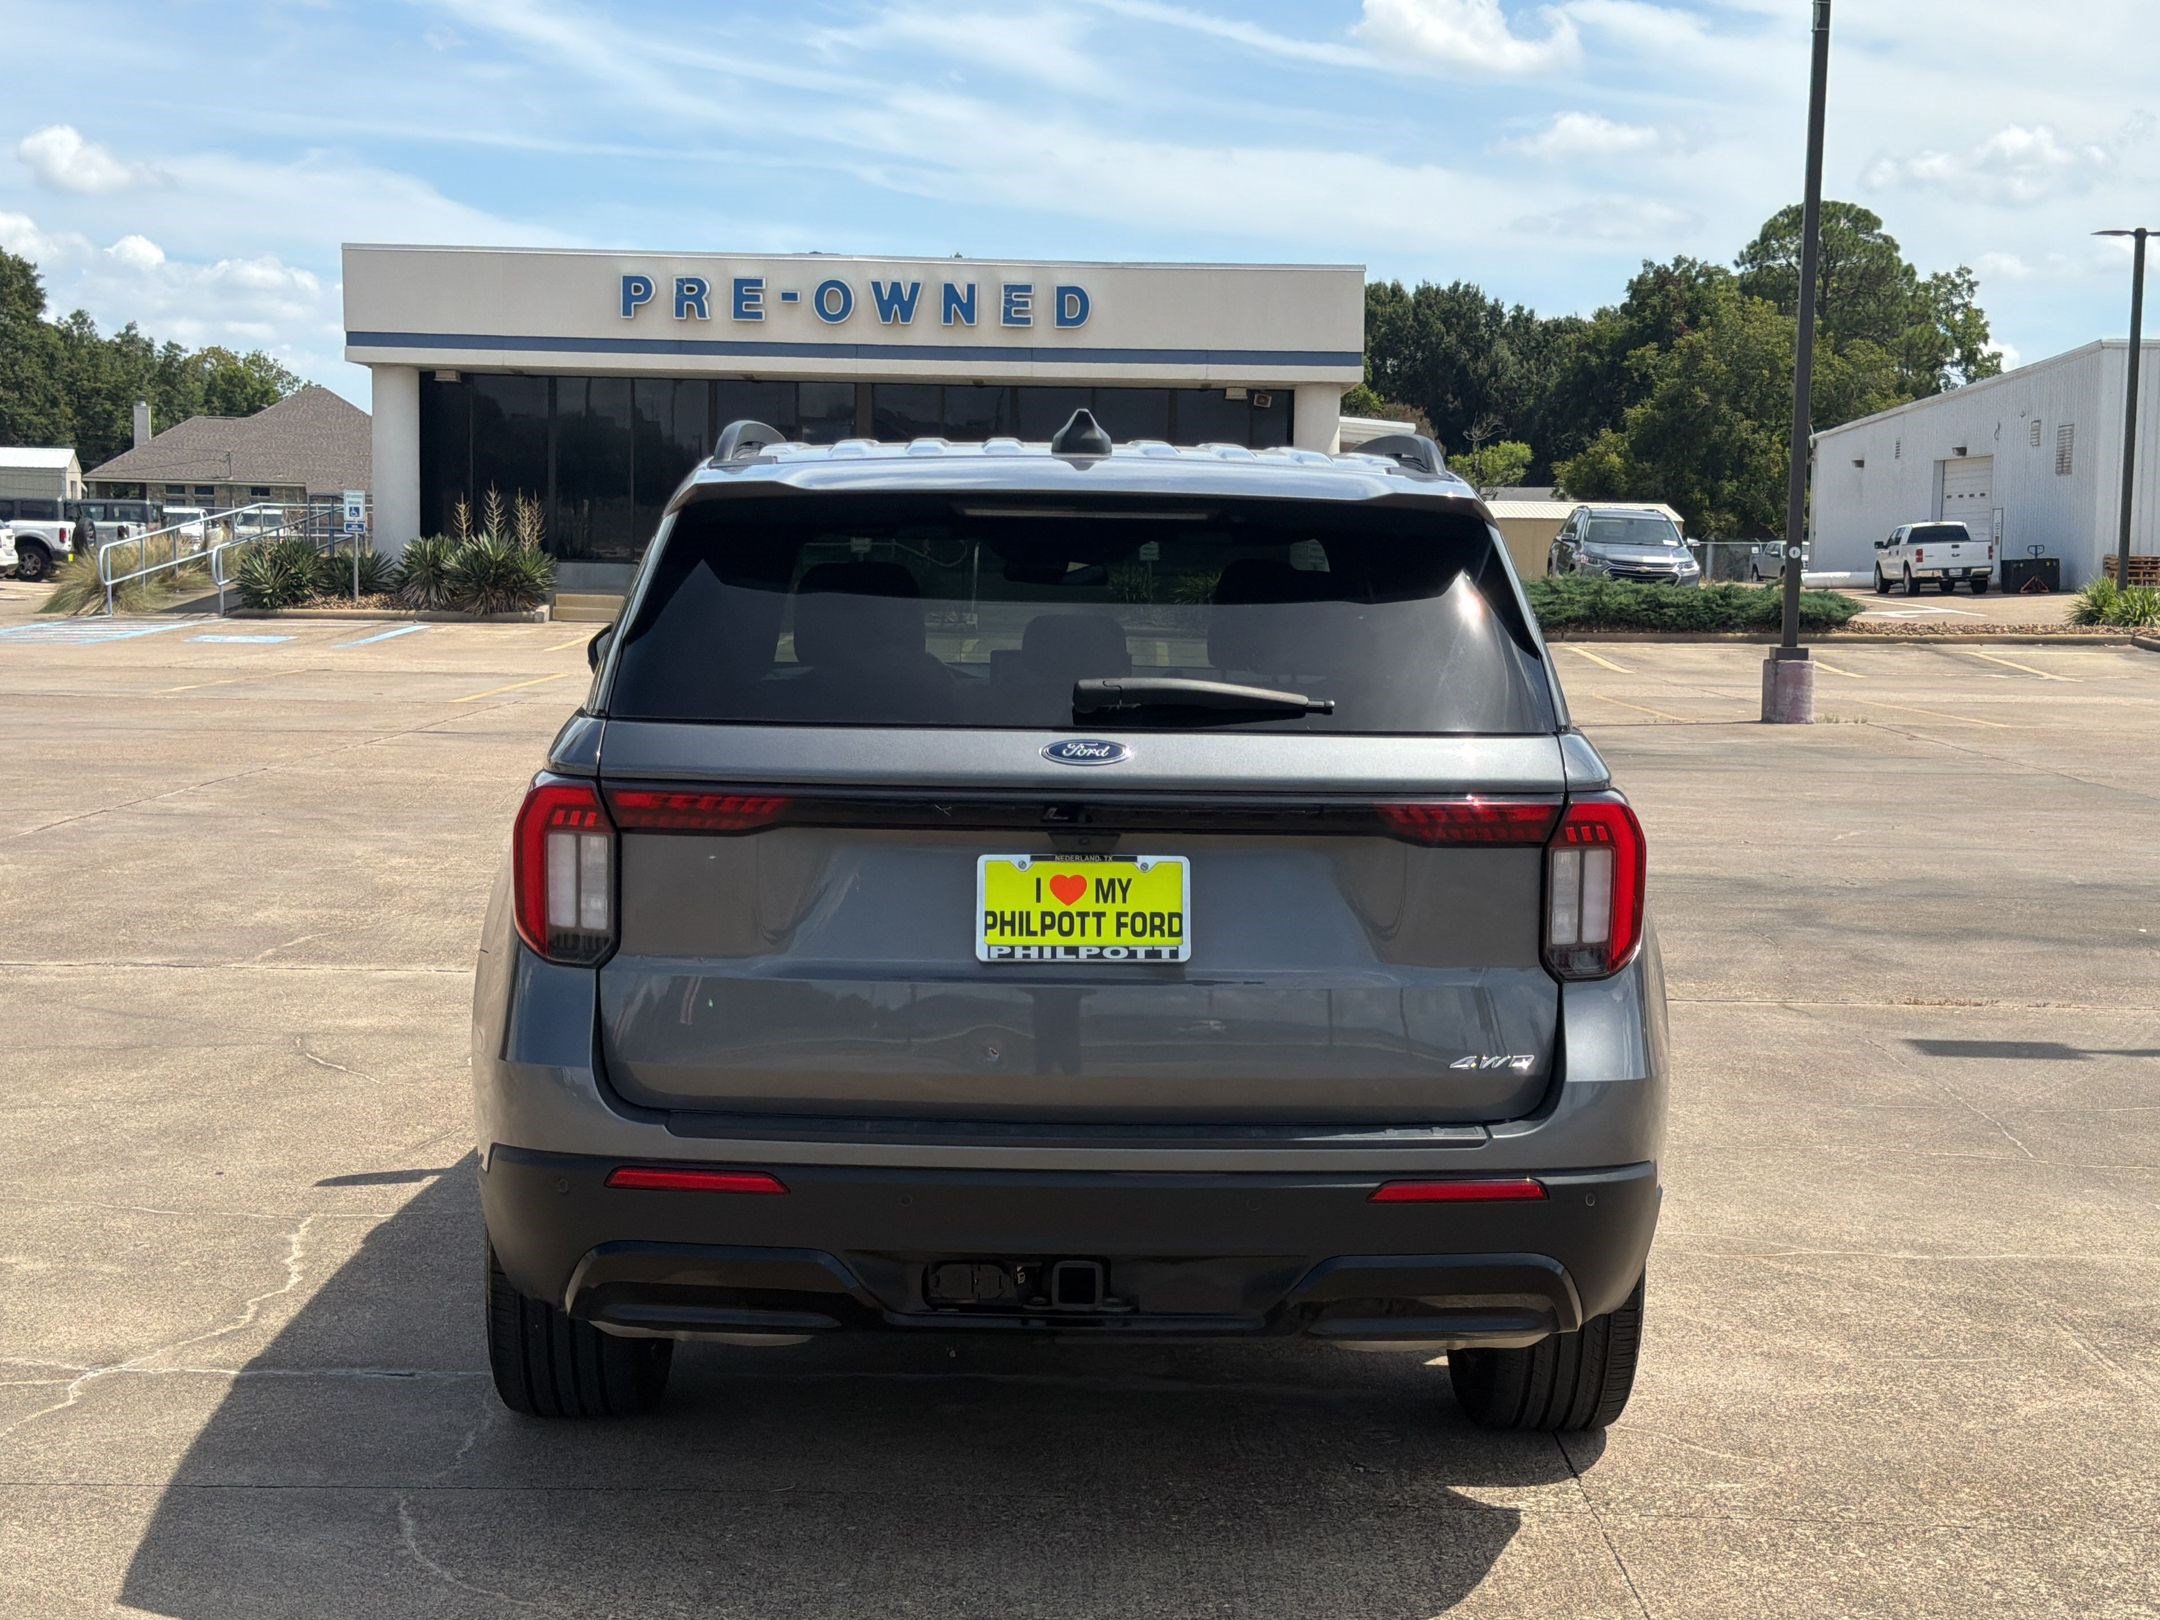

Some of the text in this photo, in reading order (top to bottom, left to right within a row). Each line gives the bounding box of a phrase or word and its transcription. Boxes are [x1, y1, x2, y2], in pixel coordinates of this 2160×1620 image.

[620, 274, 1093, 329] PRE-OWNED
[1061, 742, 1111, 758] Ford
[1103, 855, 1113, 863] TX
[1035, 877, 1133, 904] I MY
[984, 910, 1183, 938] PHILPOTT FORD
[989, 946, 1179, 960] PHILPOTT
[1449, 1054, 1535, 1070] 4WD
